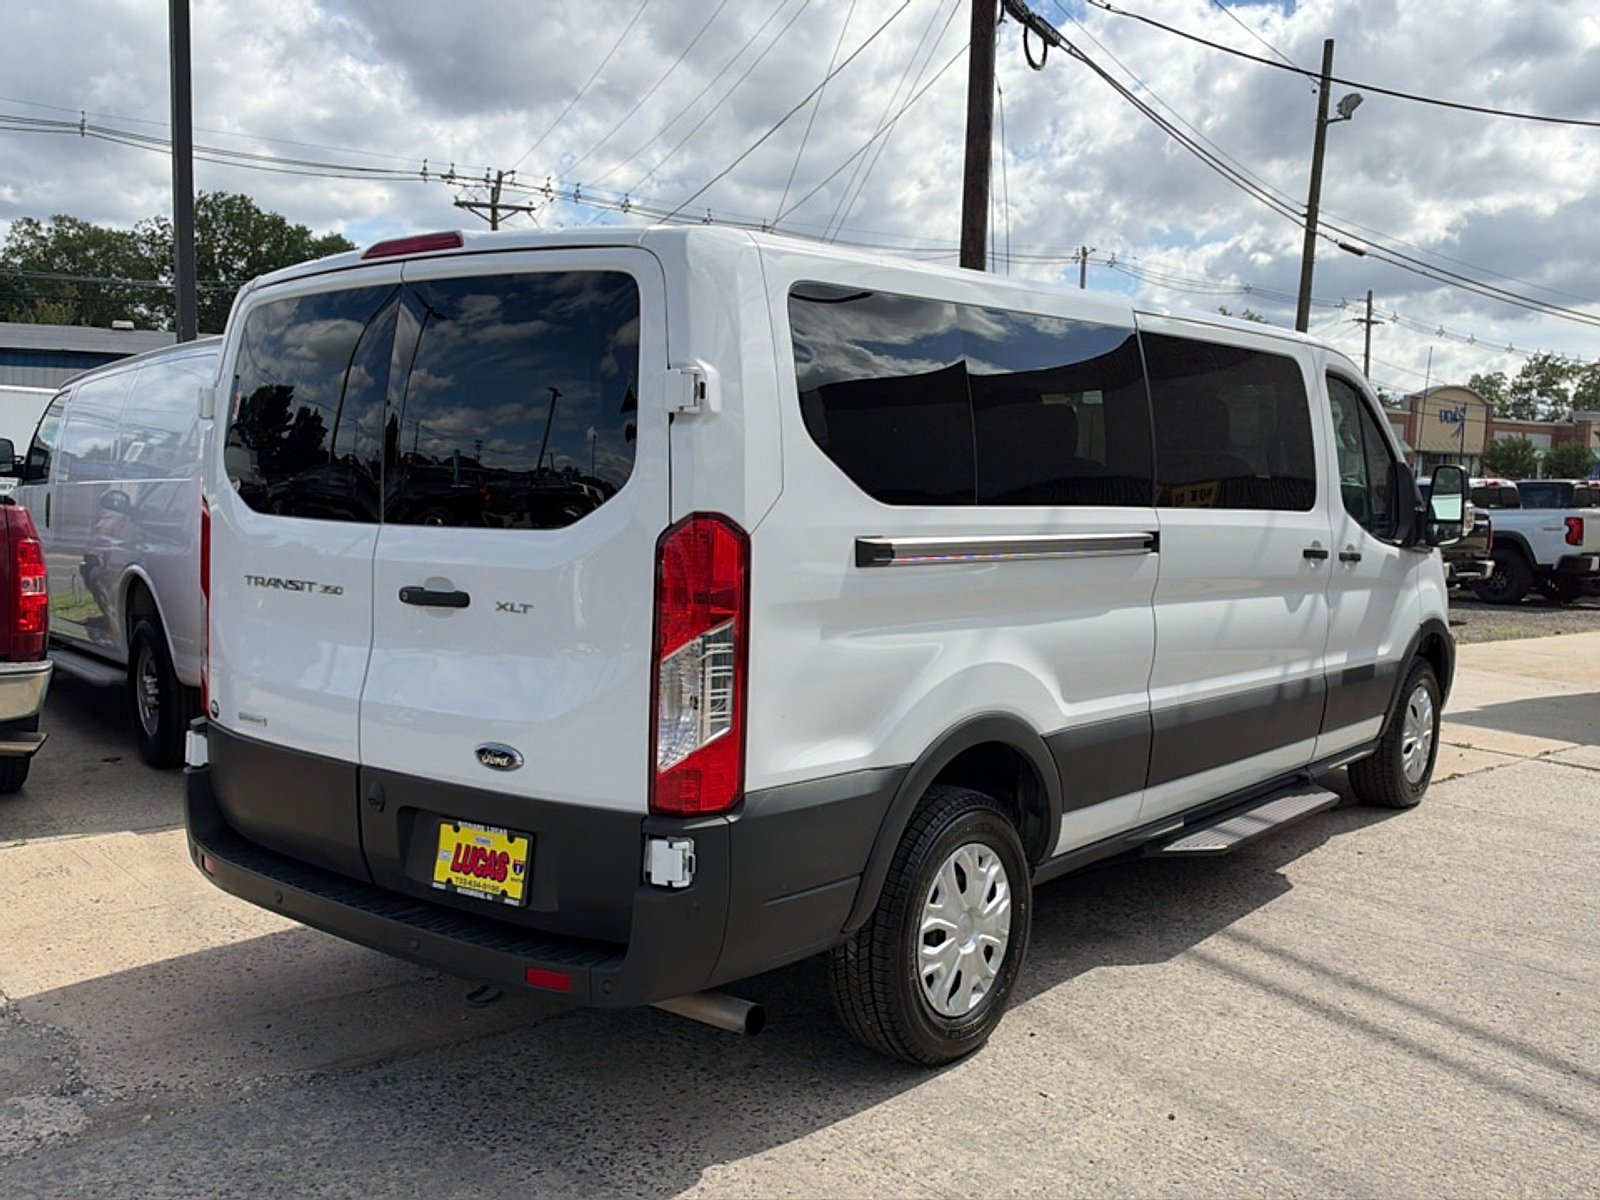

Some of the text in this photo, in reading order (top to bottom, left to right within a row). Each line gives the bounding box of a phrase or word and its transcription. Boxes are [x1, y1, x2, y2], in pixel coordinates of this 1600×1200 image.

[243, 575, 344, 596] TRANSIT 350
[495, 601, 534, 615] XLT
[450, 842, 510, 882] LUCAS
